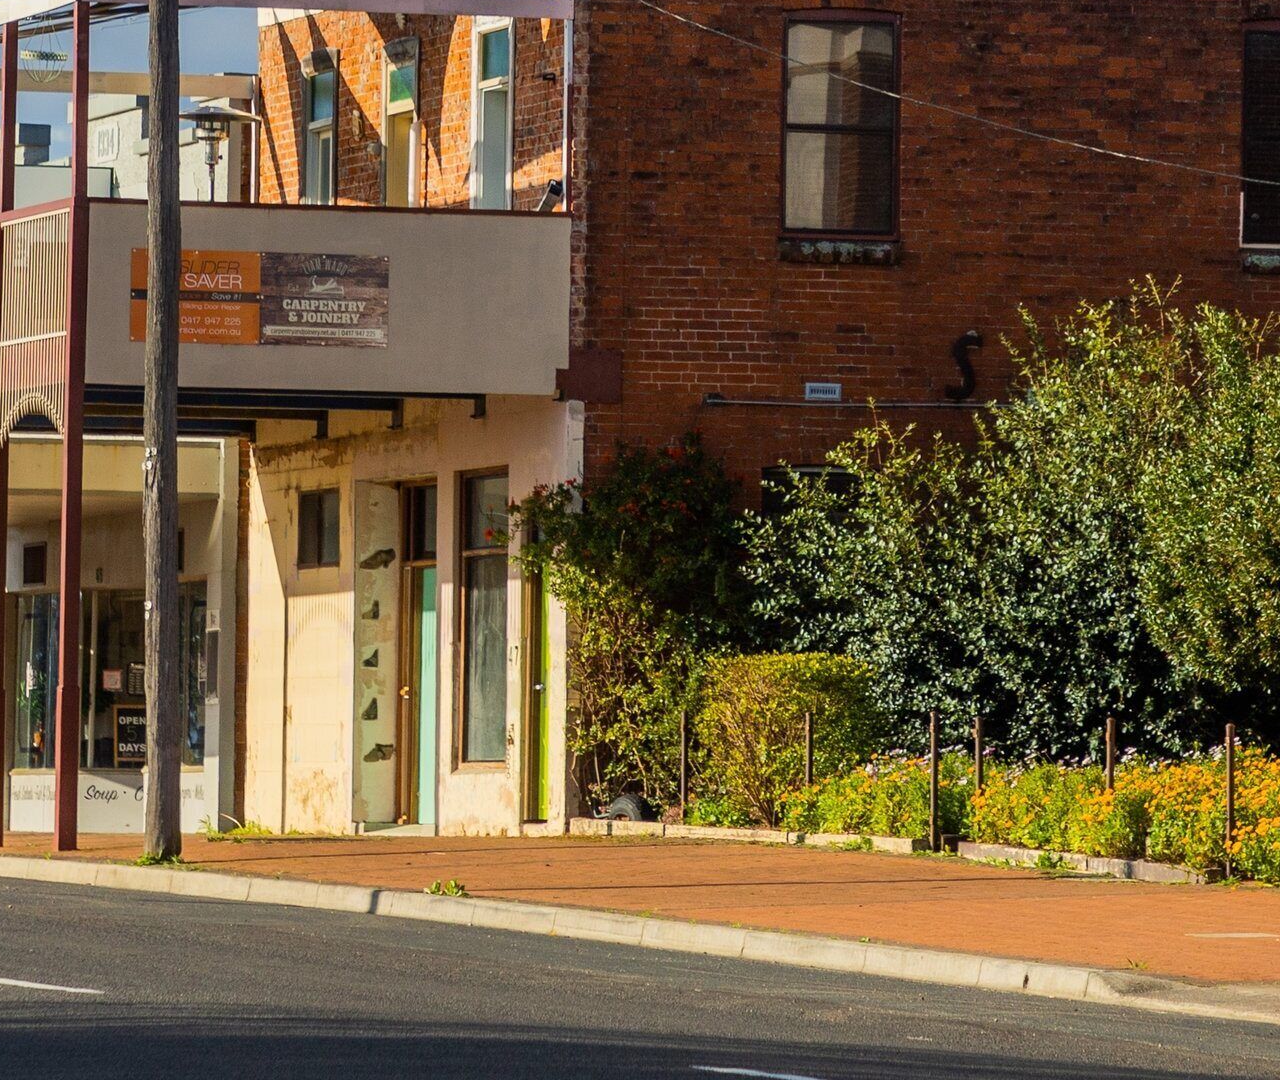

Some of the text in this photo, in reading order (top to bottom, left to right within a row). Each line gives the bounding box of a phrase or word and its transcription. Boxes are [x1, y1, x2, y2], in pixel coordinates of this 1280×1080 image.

[179, 260, 240, 275] SLIDER
[184, 273, 242, 290] SAVER
[211, 292, 231, 300] Save
[282, 299, 367, 313] CARPENTRY
[181, 316, 201, 325] 0417
[288, 311, 361, 325] & JOINERY
[118, 716, 146, 725] OPEN
[127, 725, 138, 742] 5
[118, 743, 147, 752] DAYS
[83, 784, 120, 804] Soup
